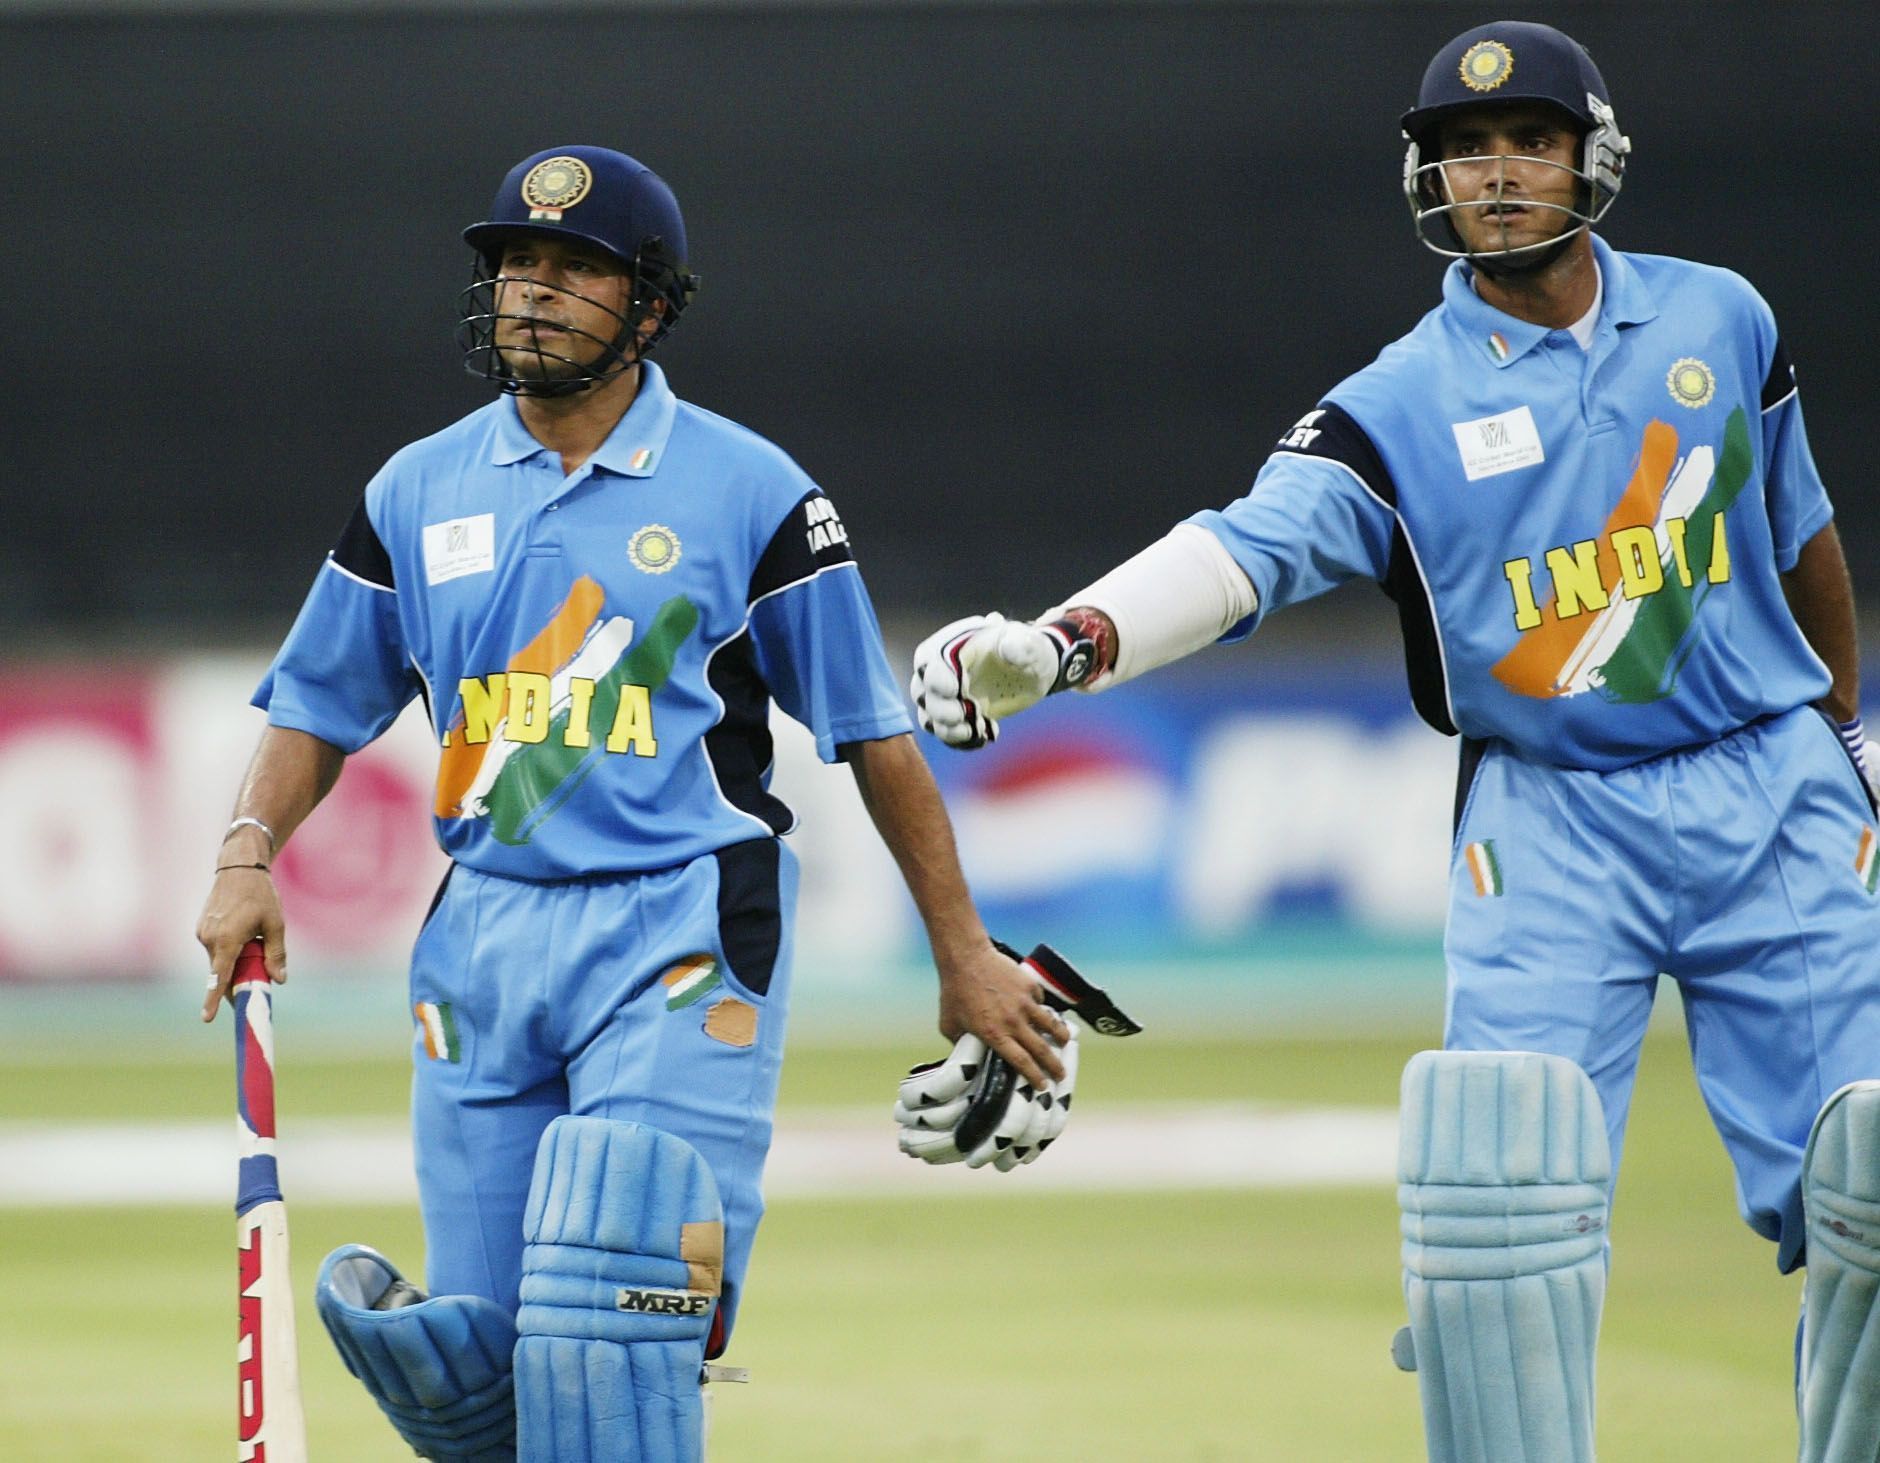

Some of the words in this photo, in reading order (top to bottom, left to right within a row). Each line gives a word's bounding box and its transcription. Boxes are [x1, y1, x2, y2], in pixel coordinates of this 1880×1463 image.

[441, 672, 657, 757] NDIA
[238, 1226, 265, 1463] MR
[620, 1289, 709, 1315] MRF
